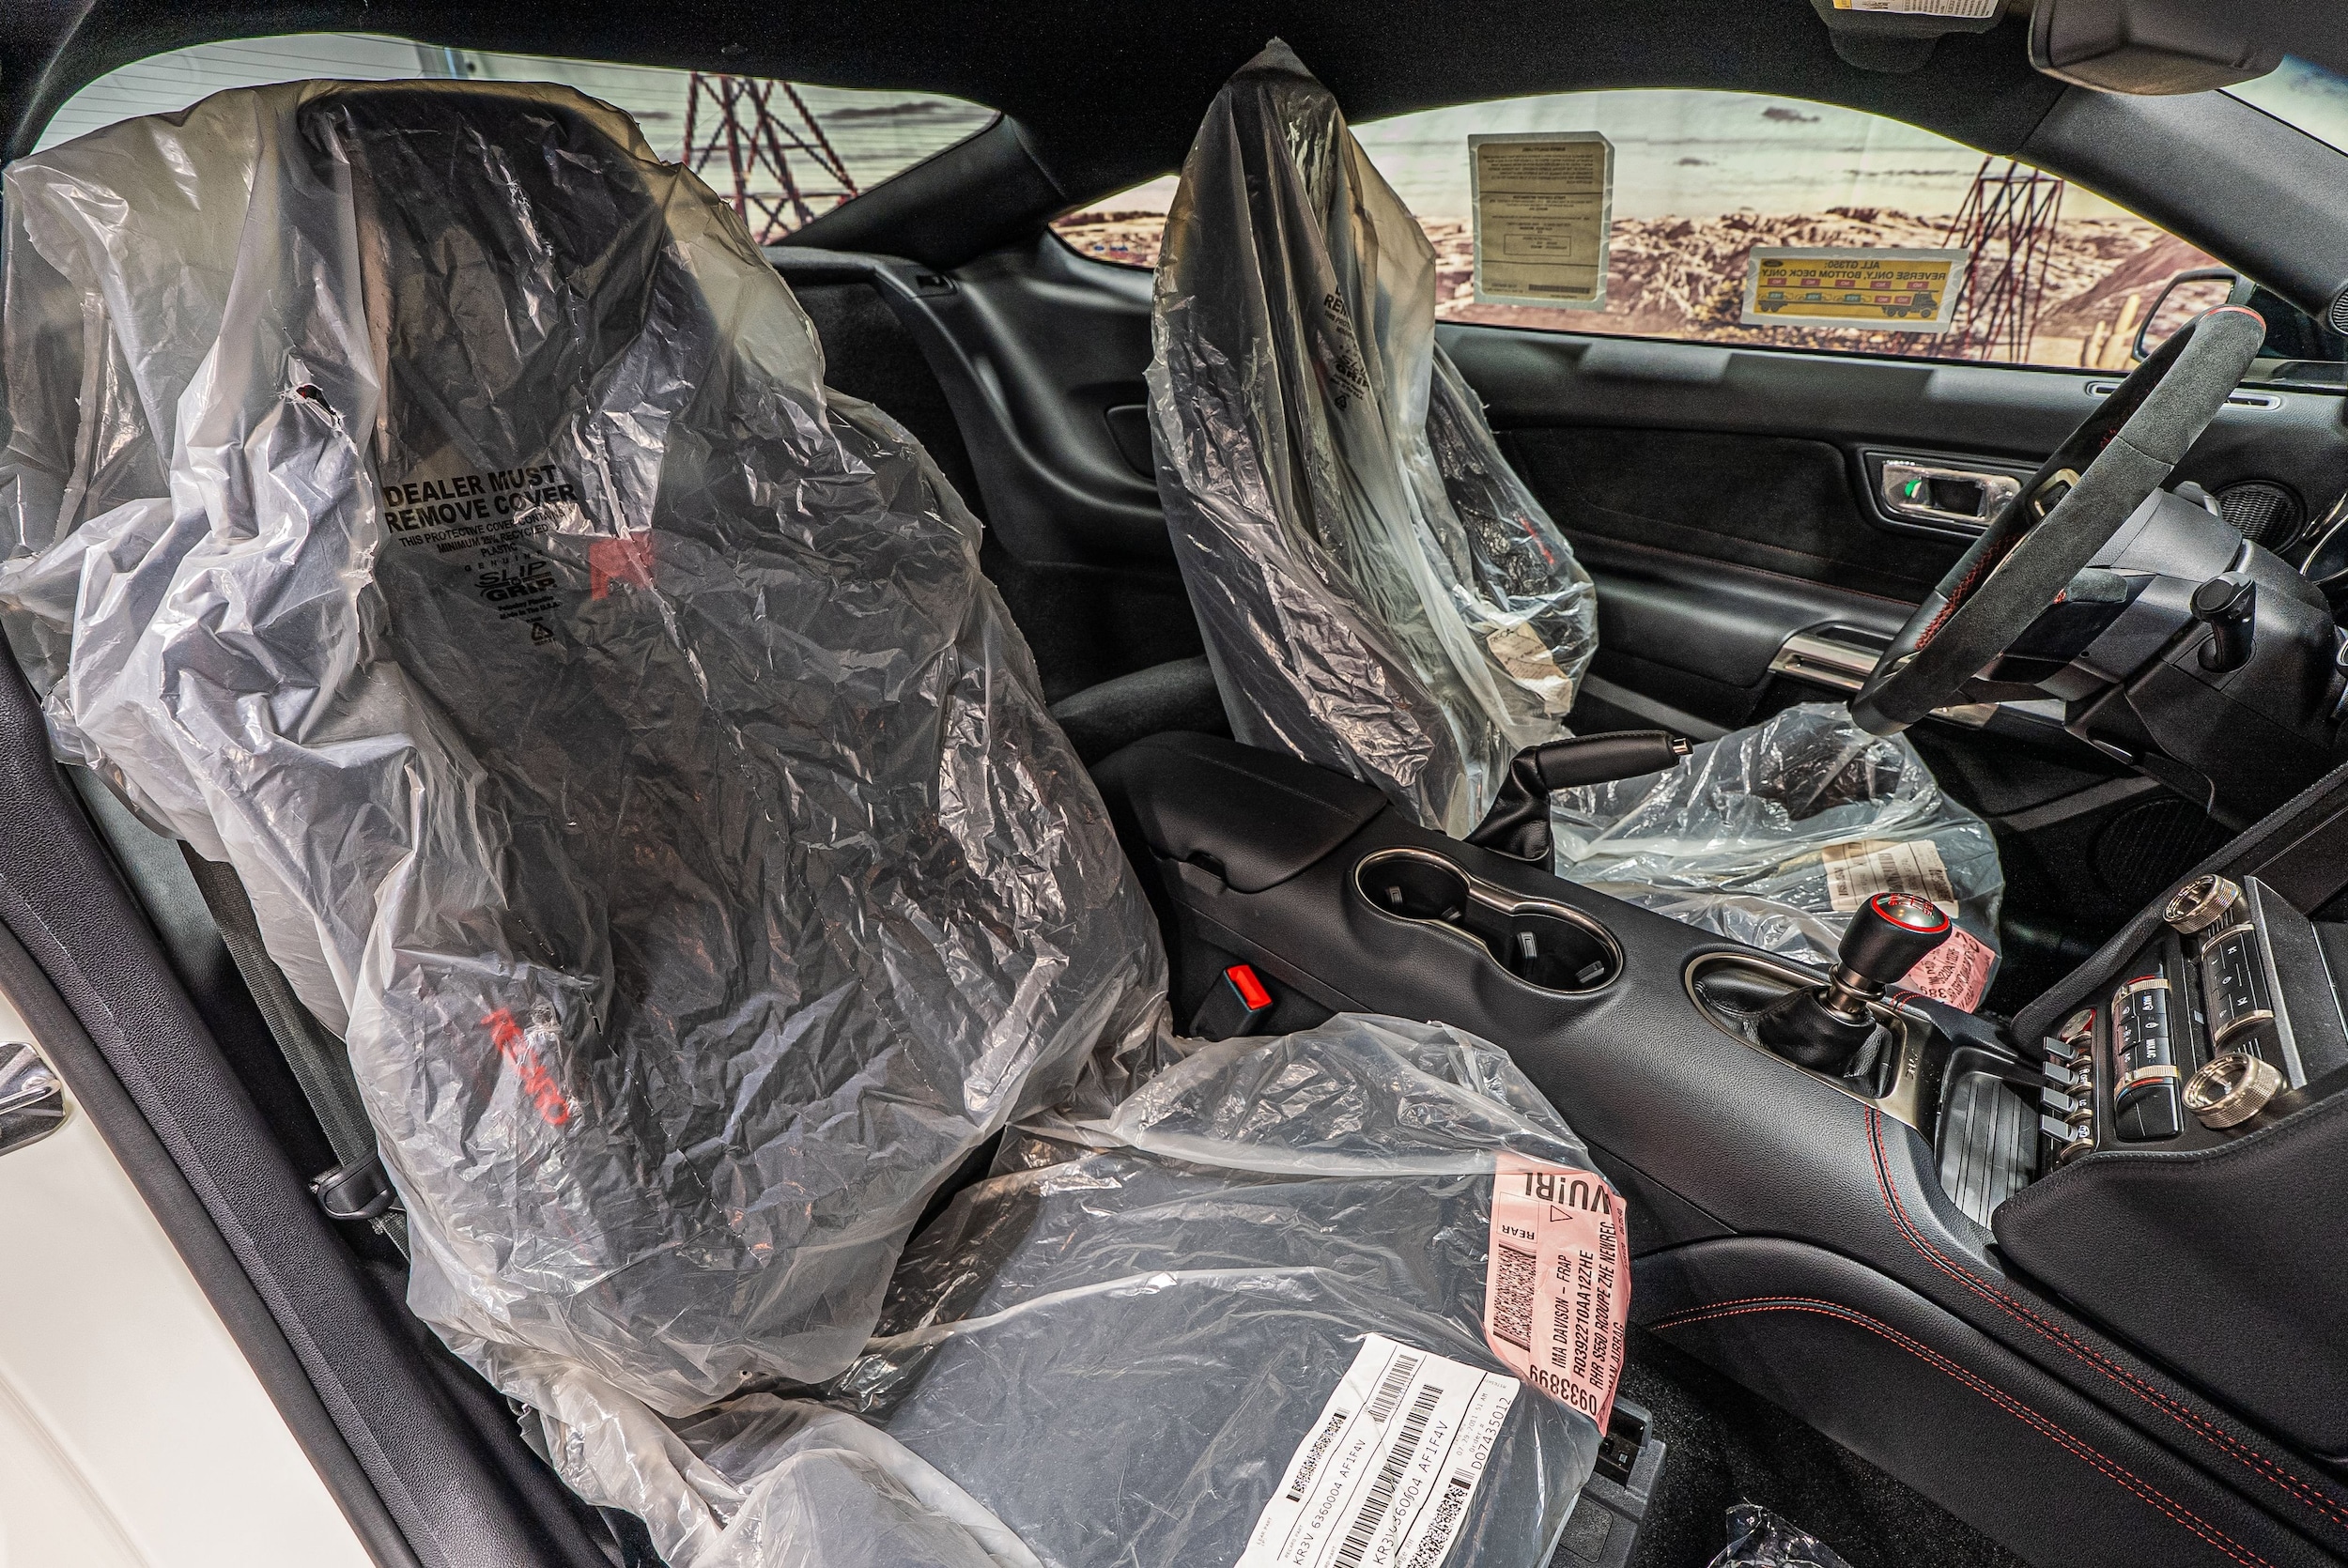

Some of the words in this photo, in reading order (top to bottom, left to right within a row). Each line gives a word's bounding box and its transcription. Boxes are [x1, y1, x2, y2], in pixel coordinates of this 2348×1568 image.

[383, 475, 487, 508] DEALER
[487, 464, 557, 494] MUST
[384, 497, 489, 533] REMOVE
[493, 484, 579, 515] COVER
[399, 535, 425, 547] THIS
[425, 524, 485, 543] PROTECTIVE
[517, 510, 565, 527] CONTAINS
[437, 538, 481, 554] MINIMUM
[501, 524, 549, 542] RECYCLED
[480, 542, 517, 558] PLASTIC
[479, 561, 548, 585] SLIP
[1502, 1224, 1535, 1240] REAR
[1556, 1254, 1572, 1284] FRAP
[1598, 1264, 1614, 1289] ZHE
[1552, 1297, 1569, 1345] DAVISON
[1595, 1287, 1611, 1334] RCOUPE
[1552, 1346, 1568, 1369] IMA
[1592, 1332, 1608, 1362] S550
[1589, 1361, 1605, 1391] RHR
[1480, 1392, 1489, 1402] AM
[1418, 1421, 1449, 1473] AF1F4V
[1469, 1432, 1482, 1453] Order
[1293, 1532, 1314, 1565] KR3V
[1311, 1482, 1343, 1529] 6360004
[1339, 1439, 1366, 1478] AF1F4V
